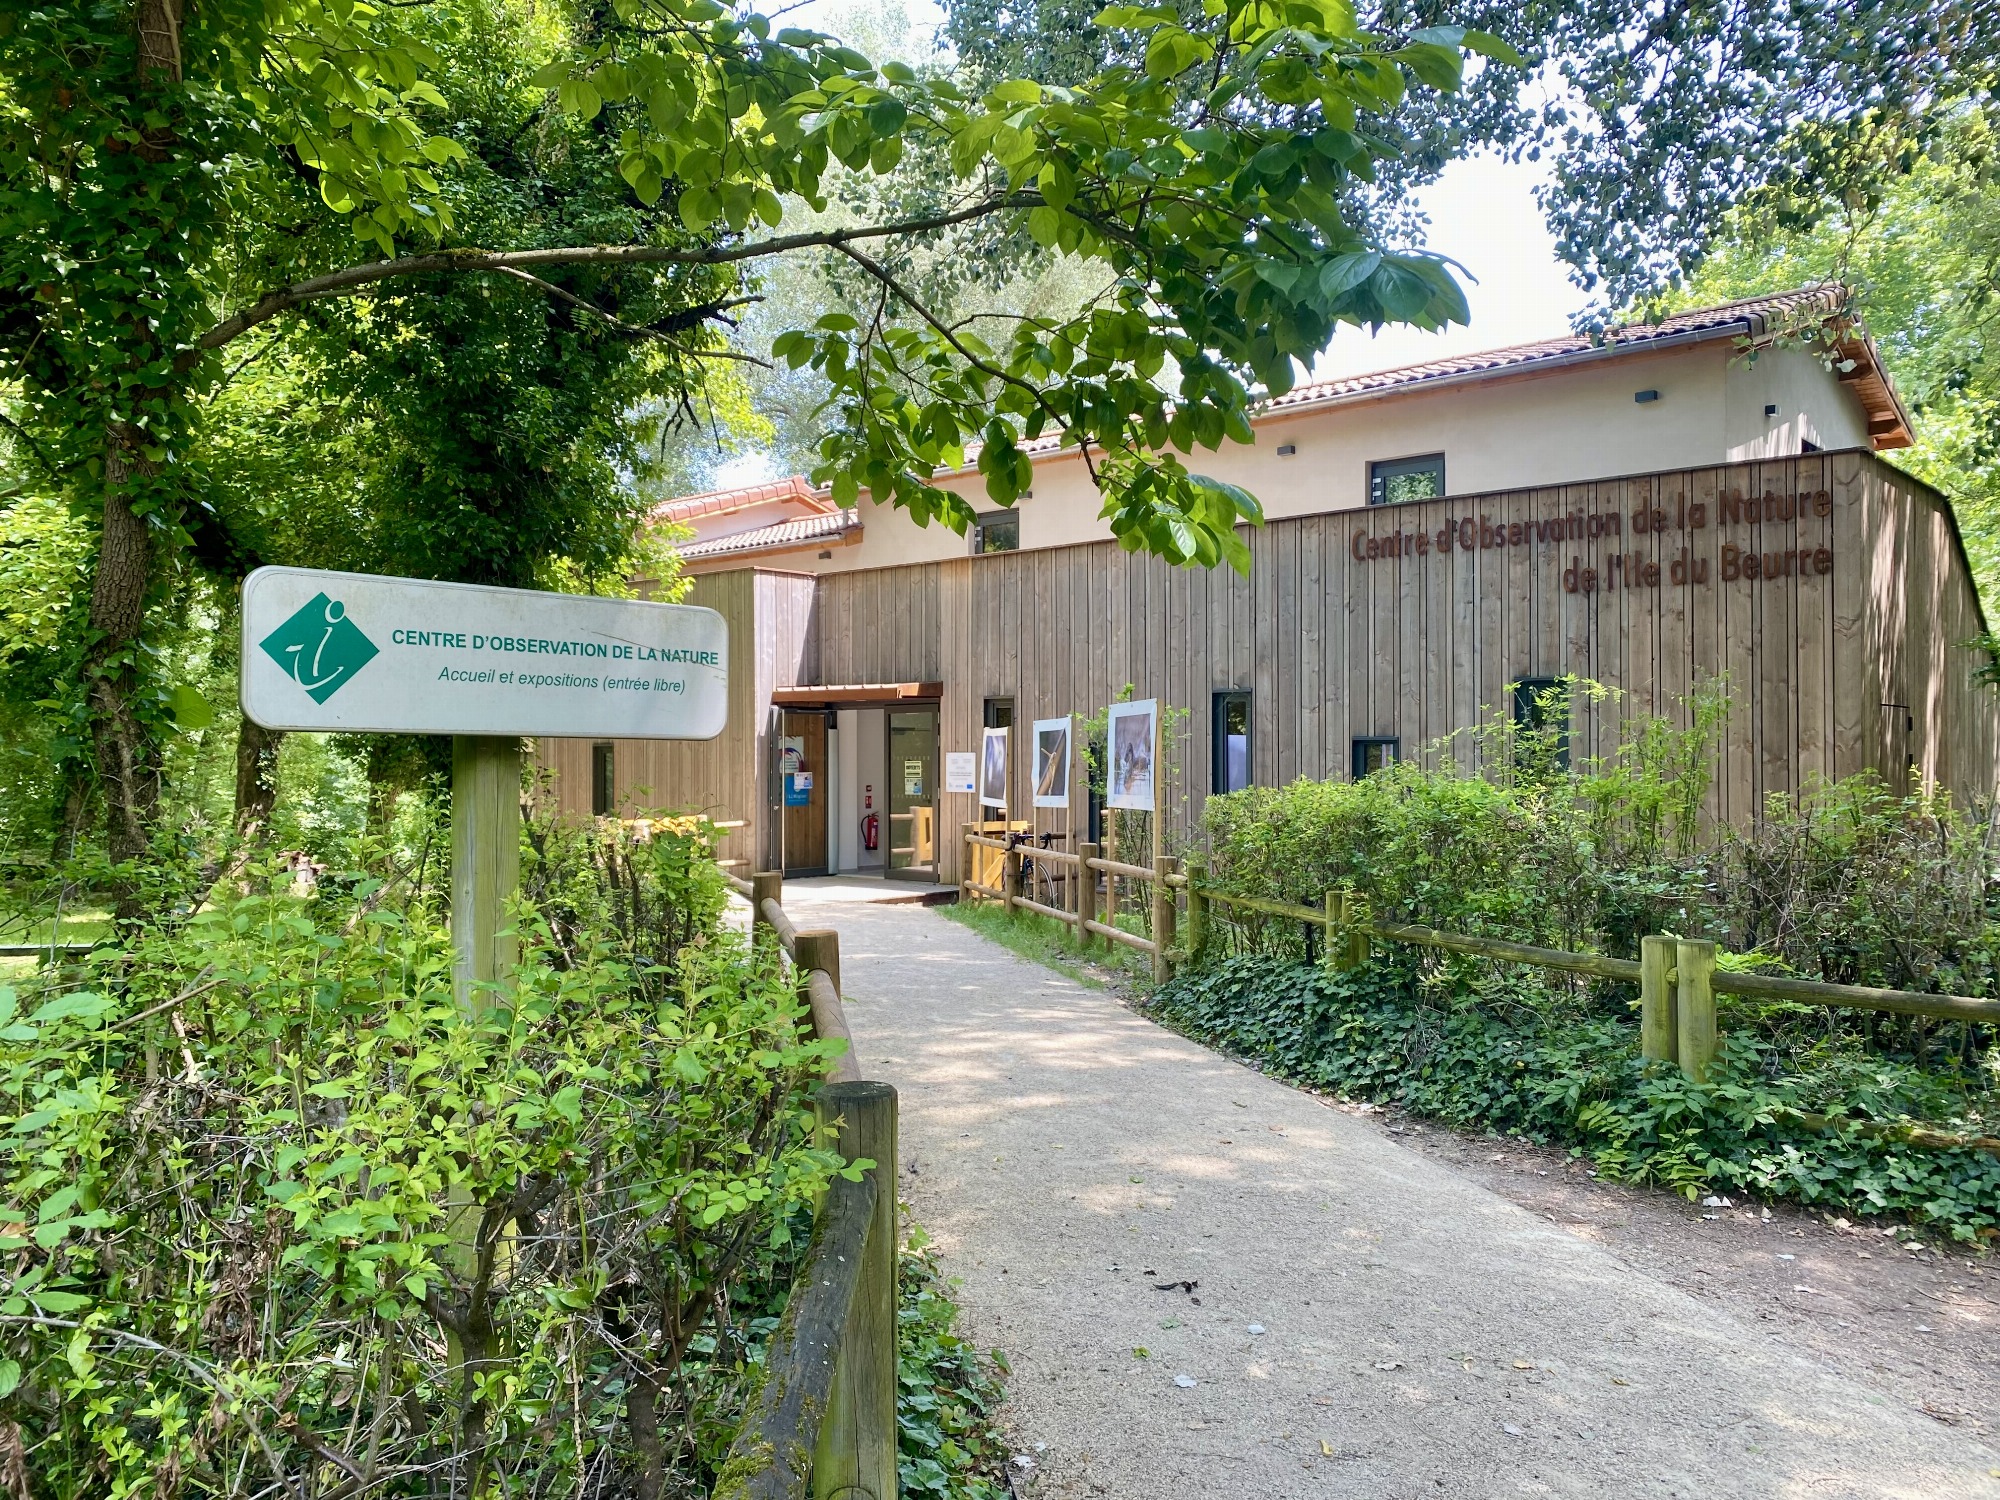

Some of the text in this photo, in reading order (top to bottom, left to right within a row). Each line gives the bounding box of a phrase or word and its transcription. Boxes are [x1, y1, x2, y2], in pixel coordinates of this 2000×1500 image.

[1351, 488, 1831, 562] Centre d'Observation de la Nature
[1563, 555, 1597, 593] de
[1670, 546, 1707, 586] du
[1721, 544, 1832, 582] Beurre
[392, 629, 719, 666] CENTRE D’OBSERVATION DE LA NATURE
[438, 666, 686, 695] Accueil et expositions (entrée libre)
